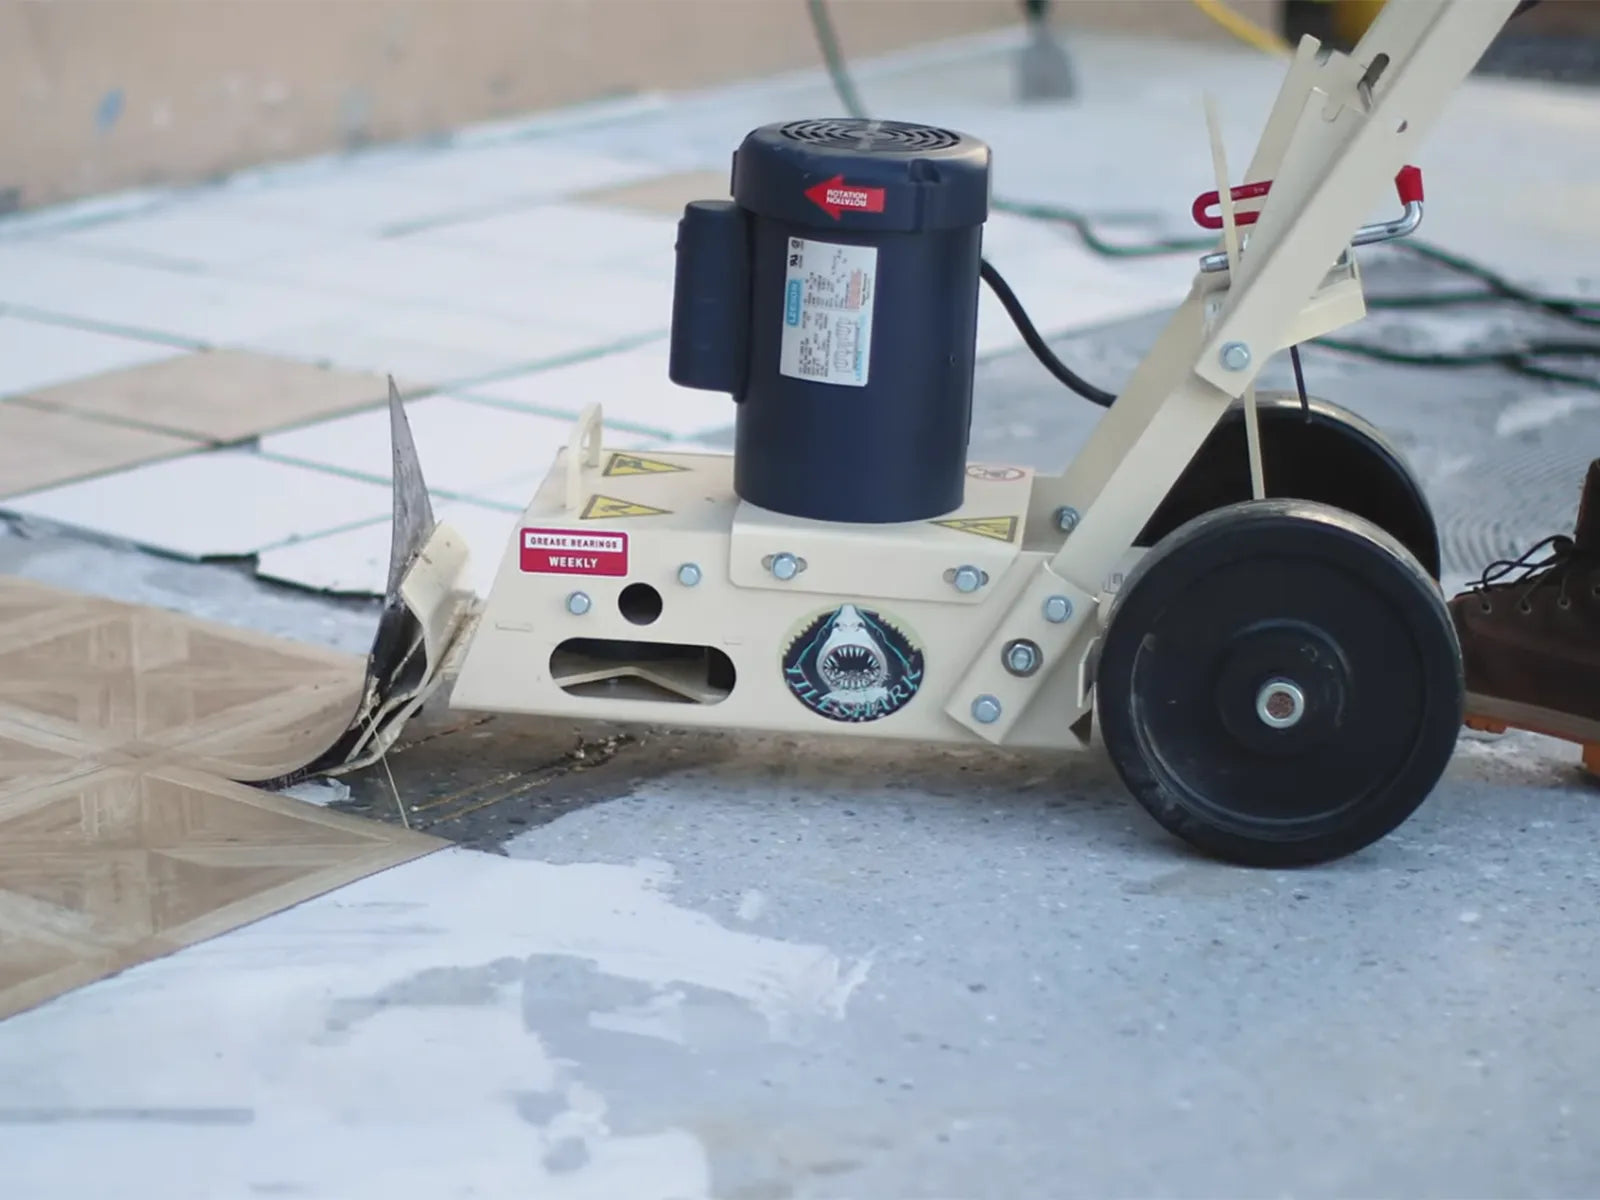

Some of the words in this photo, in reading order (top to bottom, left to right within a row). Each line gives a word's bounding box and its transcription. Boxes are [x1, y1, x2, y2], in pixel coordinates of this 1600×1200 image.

[826, 188, 867, 199] ROTATION
[530, 536, 568, 547] GREASE
[570, 538, 618, 549] BEARINGS
[548, 555, 598, 568] WEEKLY
